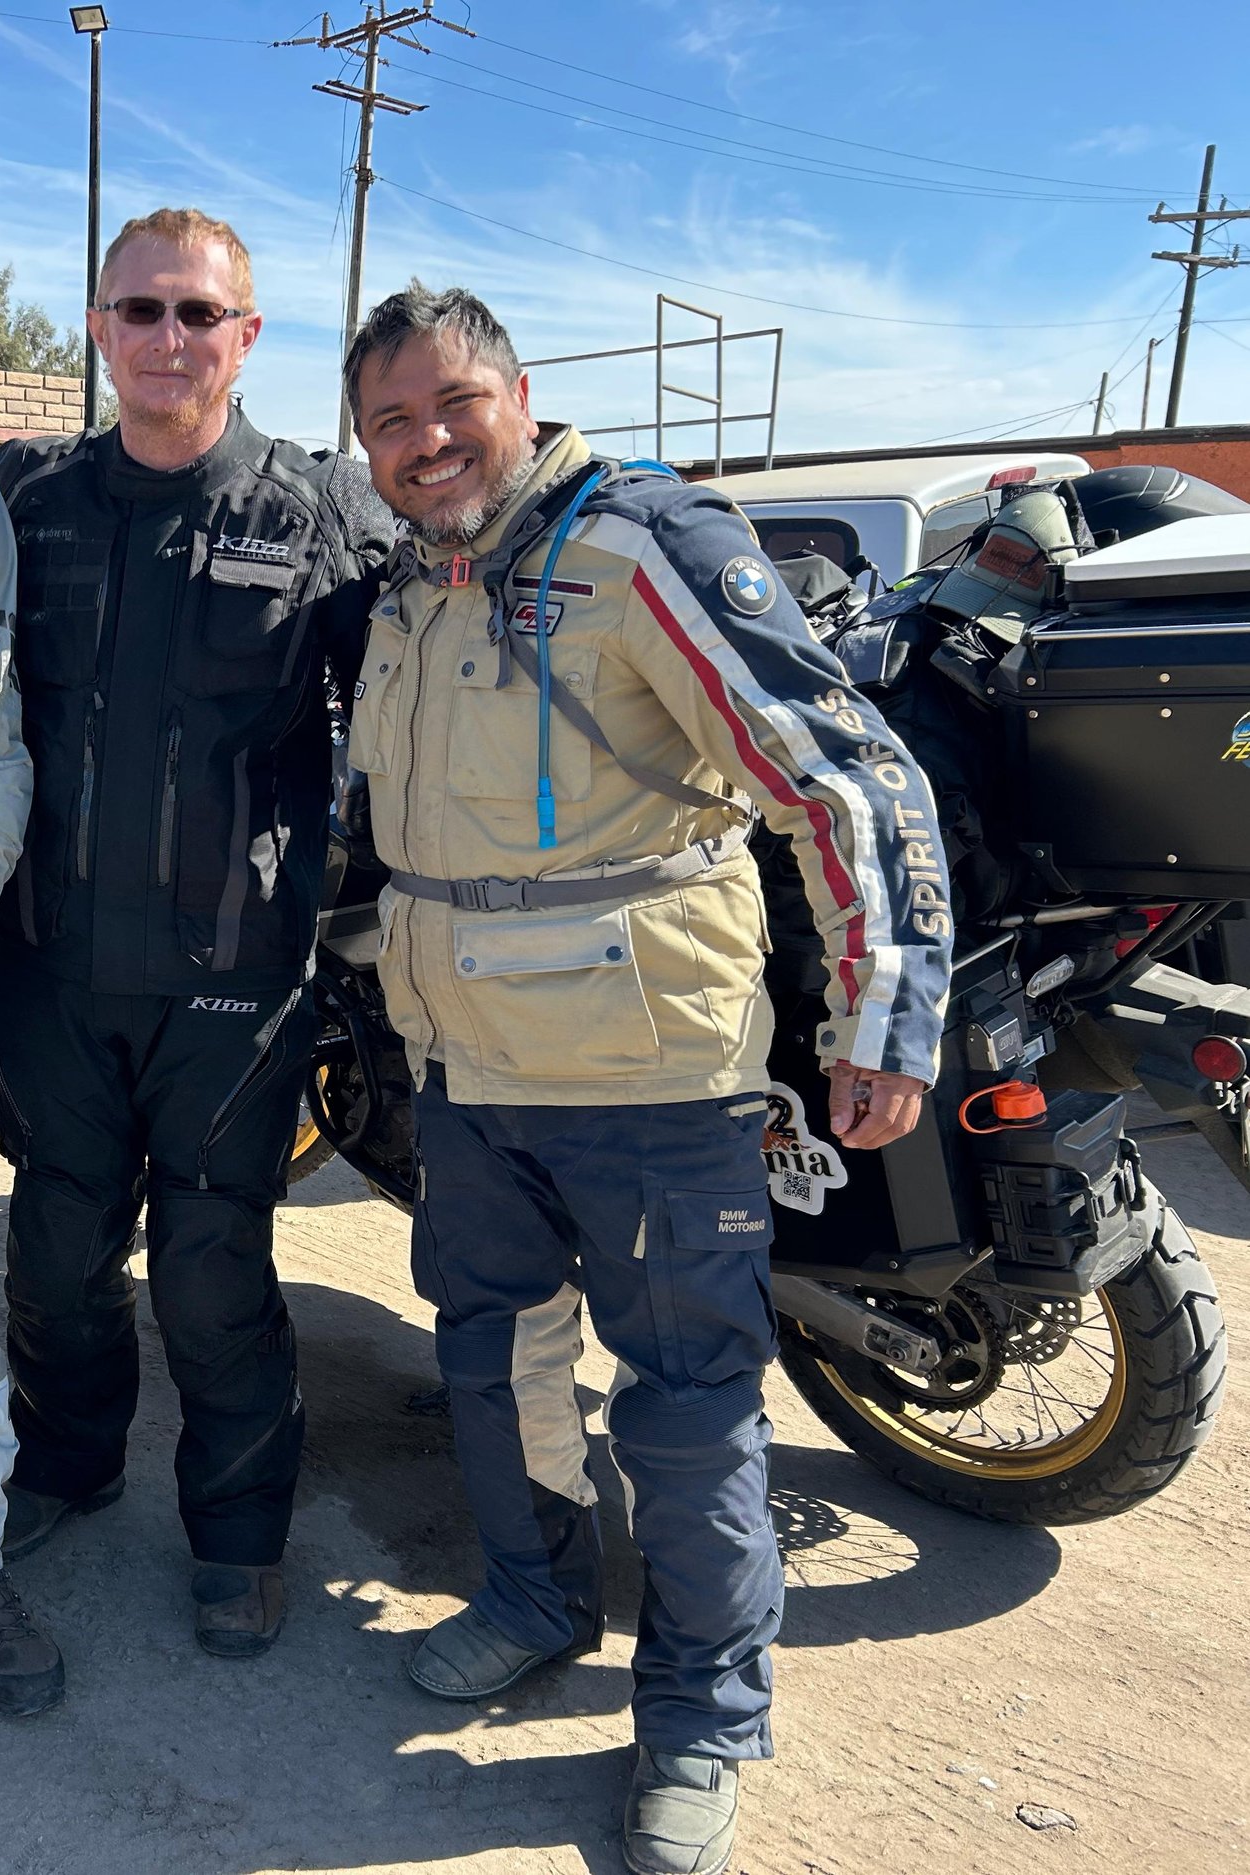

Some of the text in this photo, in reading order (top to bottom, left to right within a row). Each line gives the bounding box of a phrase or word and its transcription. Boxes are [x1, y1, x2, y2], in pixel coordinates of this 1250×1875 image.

[213, 534, 290, 556] Klim
[727, 560, 761, 583] BMW
[814, 688, 950, 937] SPIRIT OF GS
[188, 996, 259, 1013] Klim
[761, 1143, 835, 1177] nia
[719, 1210, 749, 1221] BMW
